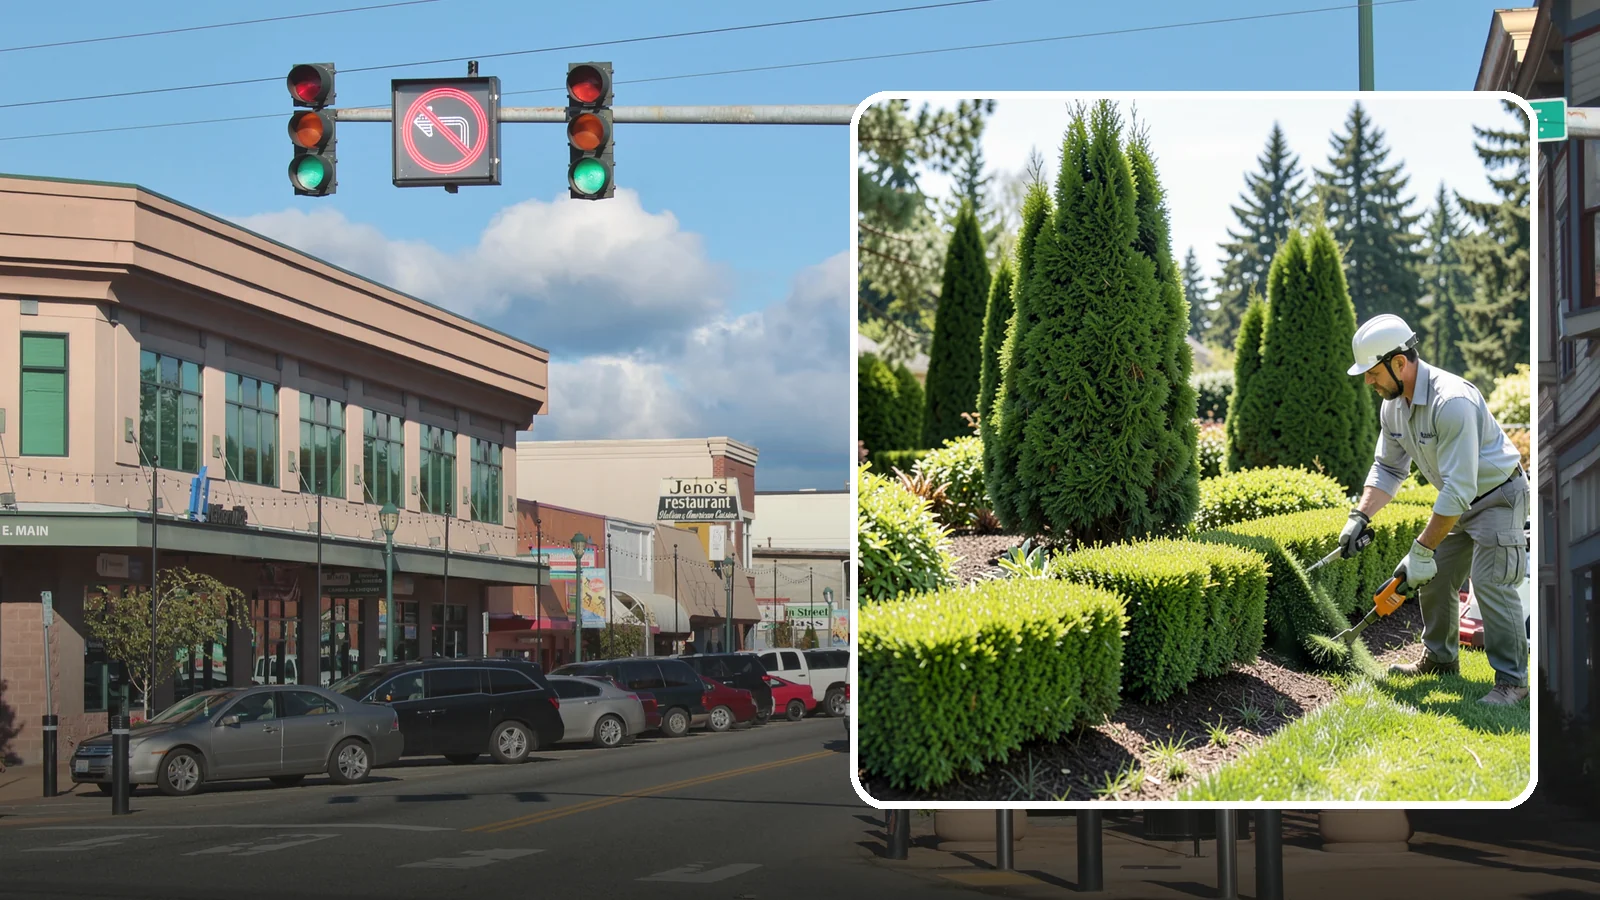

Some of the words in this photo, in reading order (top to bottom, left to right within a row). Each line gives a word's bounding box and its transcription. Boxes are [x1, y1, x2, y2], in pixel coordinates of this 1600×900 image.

[670, 480, 727, 494] Jeno's
[665, 496, 731, 509] restaurant
[658, 510, 681, 519] Italian
[686, 509, 714, 519] American
[715, 509, 737, 519] Cuisine
[2, 525, 13, 536] E.
[15, 525, 49, 536] MAIN
[792, 619, 824, 627] lass
